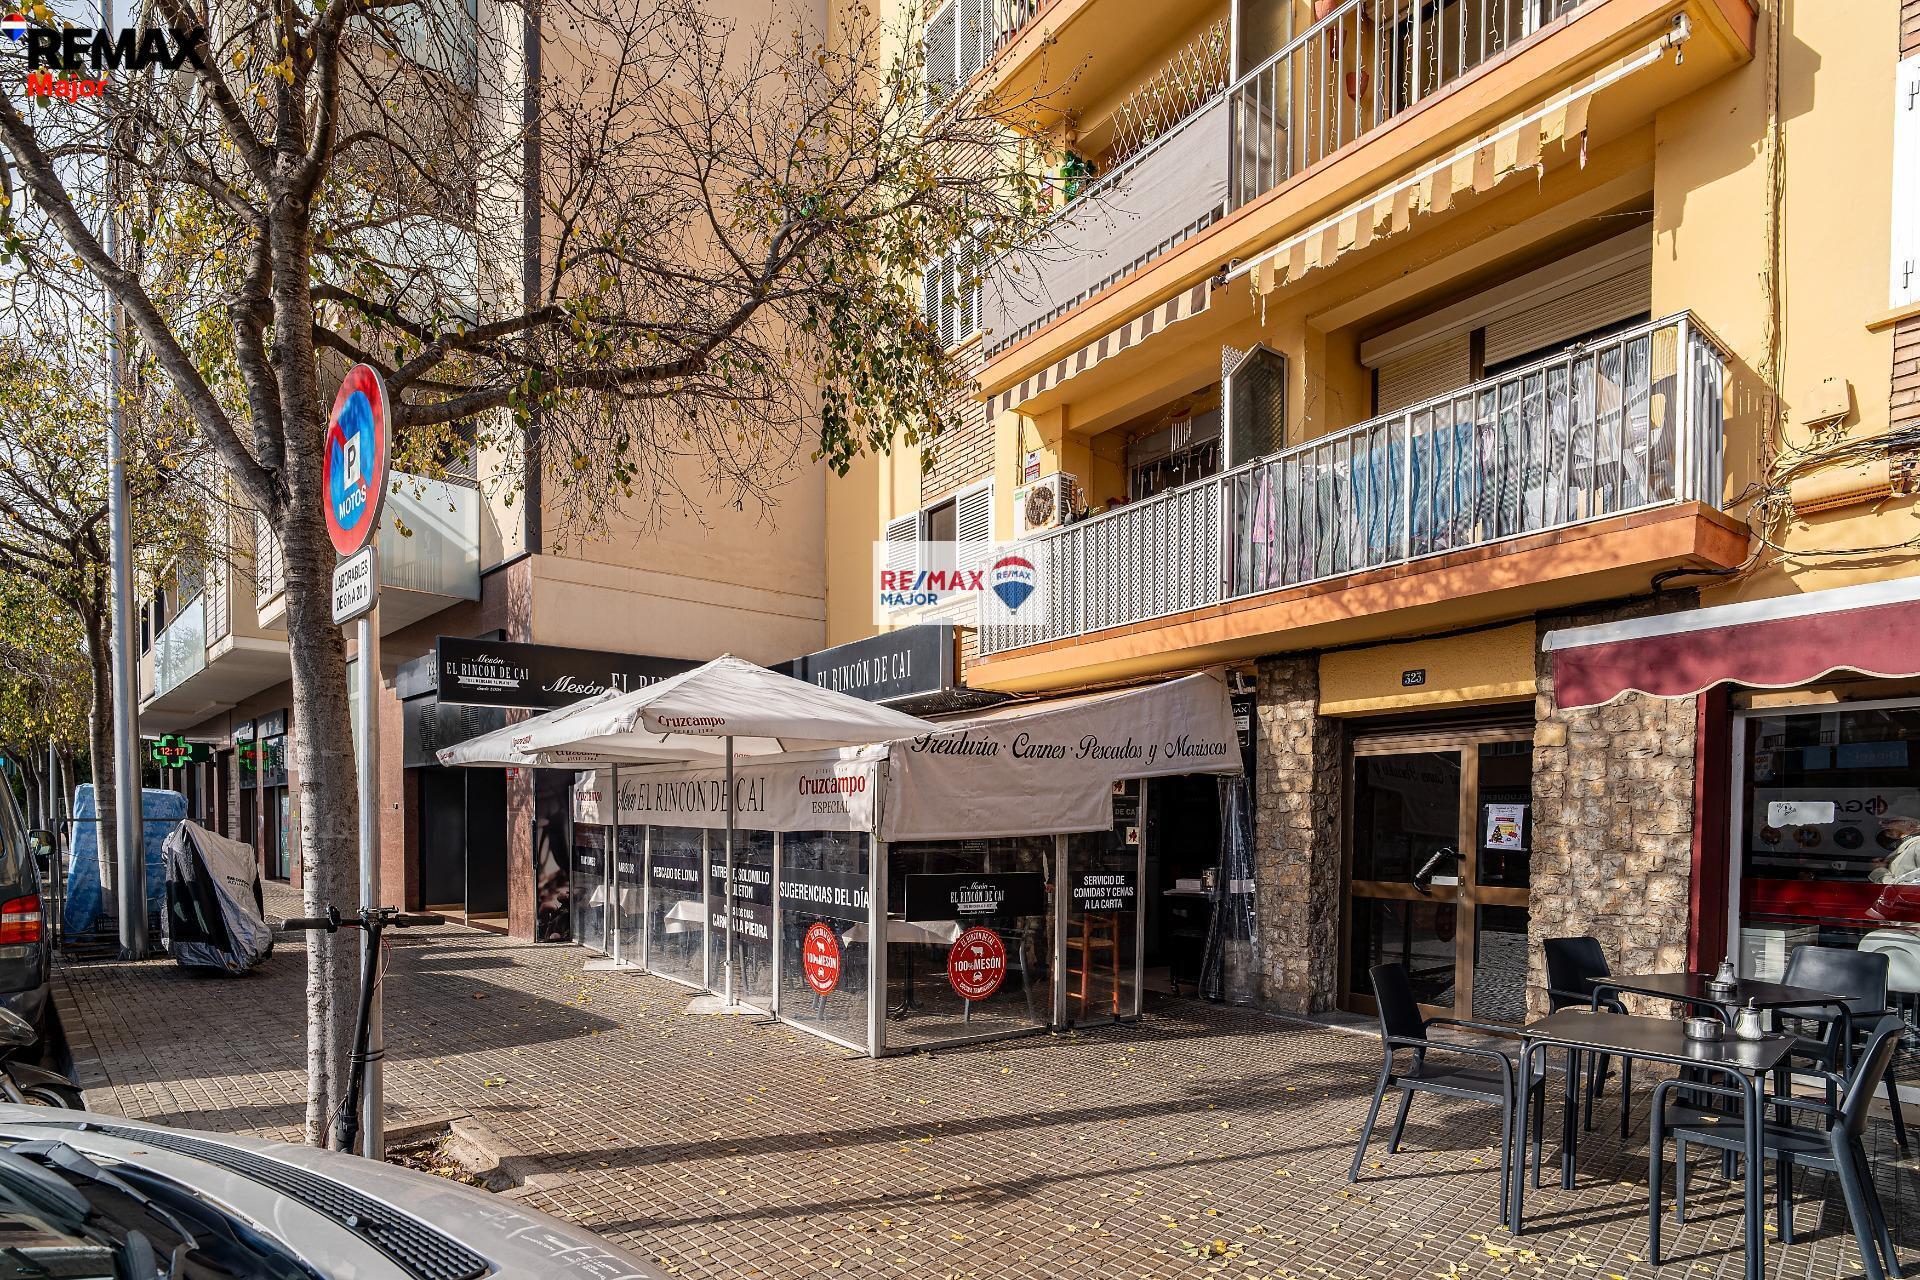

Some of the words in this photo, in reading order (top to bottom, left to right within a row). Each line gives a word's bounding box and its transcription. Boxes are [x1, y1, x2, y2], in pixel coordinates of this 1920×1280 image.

[348, 444, 357, 480] P
[339, 484, 367, 521] MOTOS
[335, 559, 368, 592] LABORABLES
[336, 594, 343, 612] DE
[352, 588, 356, 604] A
[471, 654, 506, 664] Mesón
[446, 662, 458, 675] EL
[462, 663, 496, 678] RINCÓN
[500, 666, 511, 679] DE
[514, 668, 529, 680] CAI
[832, 658, 870, 692] RINCÓN
[874, 656, 888, 684] DE
[892, 650, 912, 680] CAI
[1404, 672, 1422, 684] 323
[542, 676, 605, 695] Mesón
[658, 715, 726, 728] Cruzcampo
[160, 747, 185, 756] 12:17
[910, 732, 1000, 757] Freiduría
[1012, 732, 1066, 760] Carnes
[1075, 734, 1142, 760] Pescados
[1144, 745, 1158, 766] y
[1164, 734, 1228, 759] Mariscos
[637, 783, 652, 811] EL
[656, 773, 708, 812] RINCÓN
[710, 780, 728, 812] DE
[736, 777, 765, 812] CAI
[798, 774, 866, 797] Cruzcampo
[812, 800, 850, 814] ESPECIAL
[654, 866, 674, 880] PESCADO
[674, 870, 681, 880] DE
[682, 870, 698, 882] LONJA
[738, 868, 770, 885] SOLOMILLO
[1084, 875, 1114, 886] SERVICIO
[1115, 875, 1125, 885] DE
[780, 881, 832, 904] SUGERENCIAS
[834, 888, 852, 906] DEL
[854, 886, 870, 909] DÍA
[950, 891, 958, 904] EL
[960, 890, 983, 903] RINCÓN
[984, 890, 993, 902] DE
[994, 890, 1004, 902] CAI
[1074, 887, 1106, 898] COMIDAS
[1106, 887, 1111, 897] Y
[1112, 886, 1134, 897] CENAS
[1085, 900, 1090, 910] A
[1091, 899, 1100, 909] LA
[1100, 898, 1123, 909] CARTA
[745, 920, 768, 940] PIEDRA
